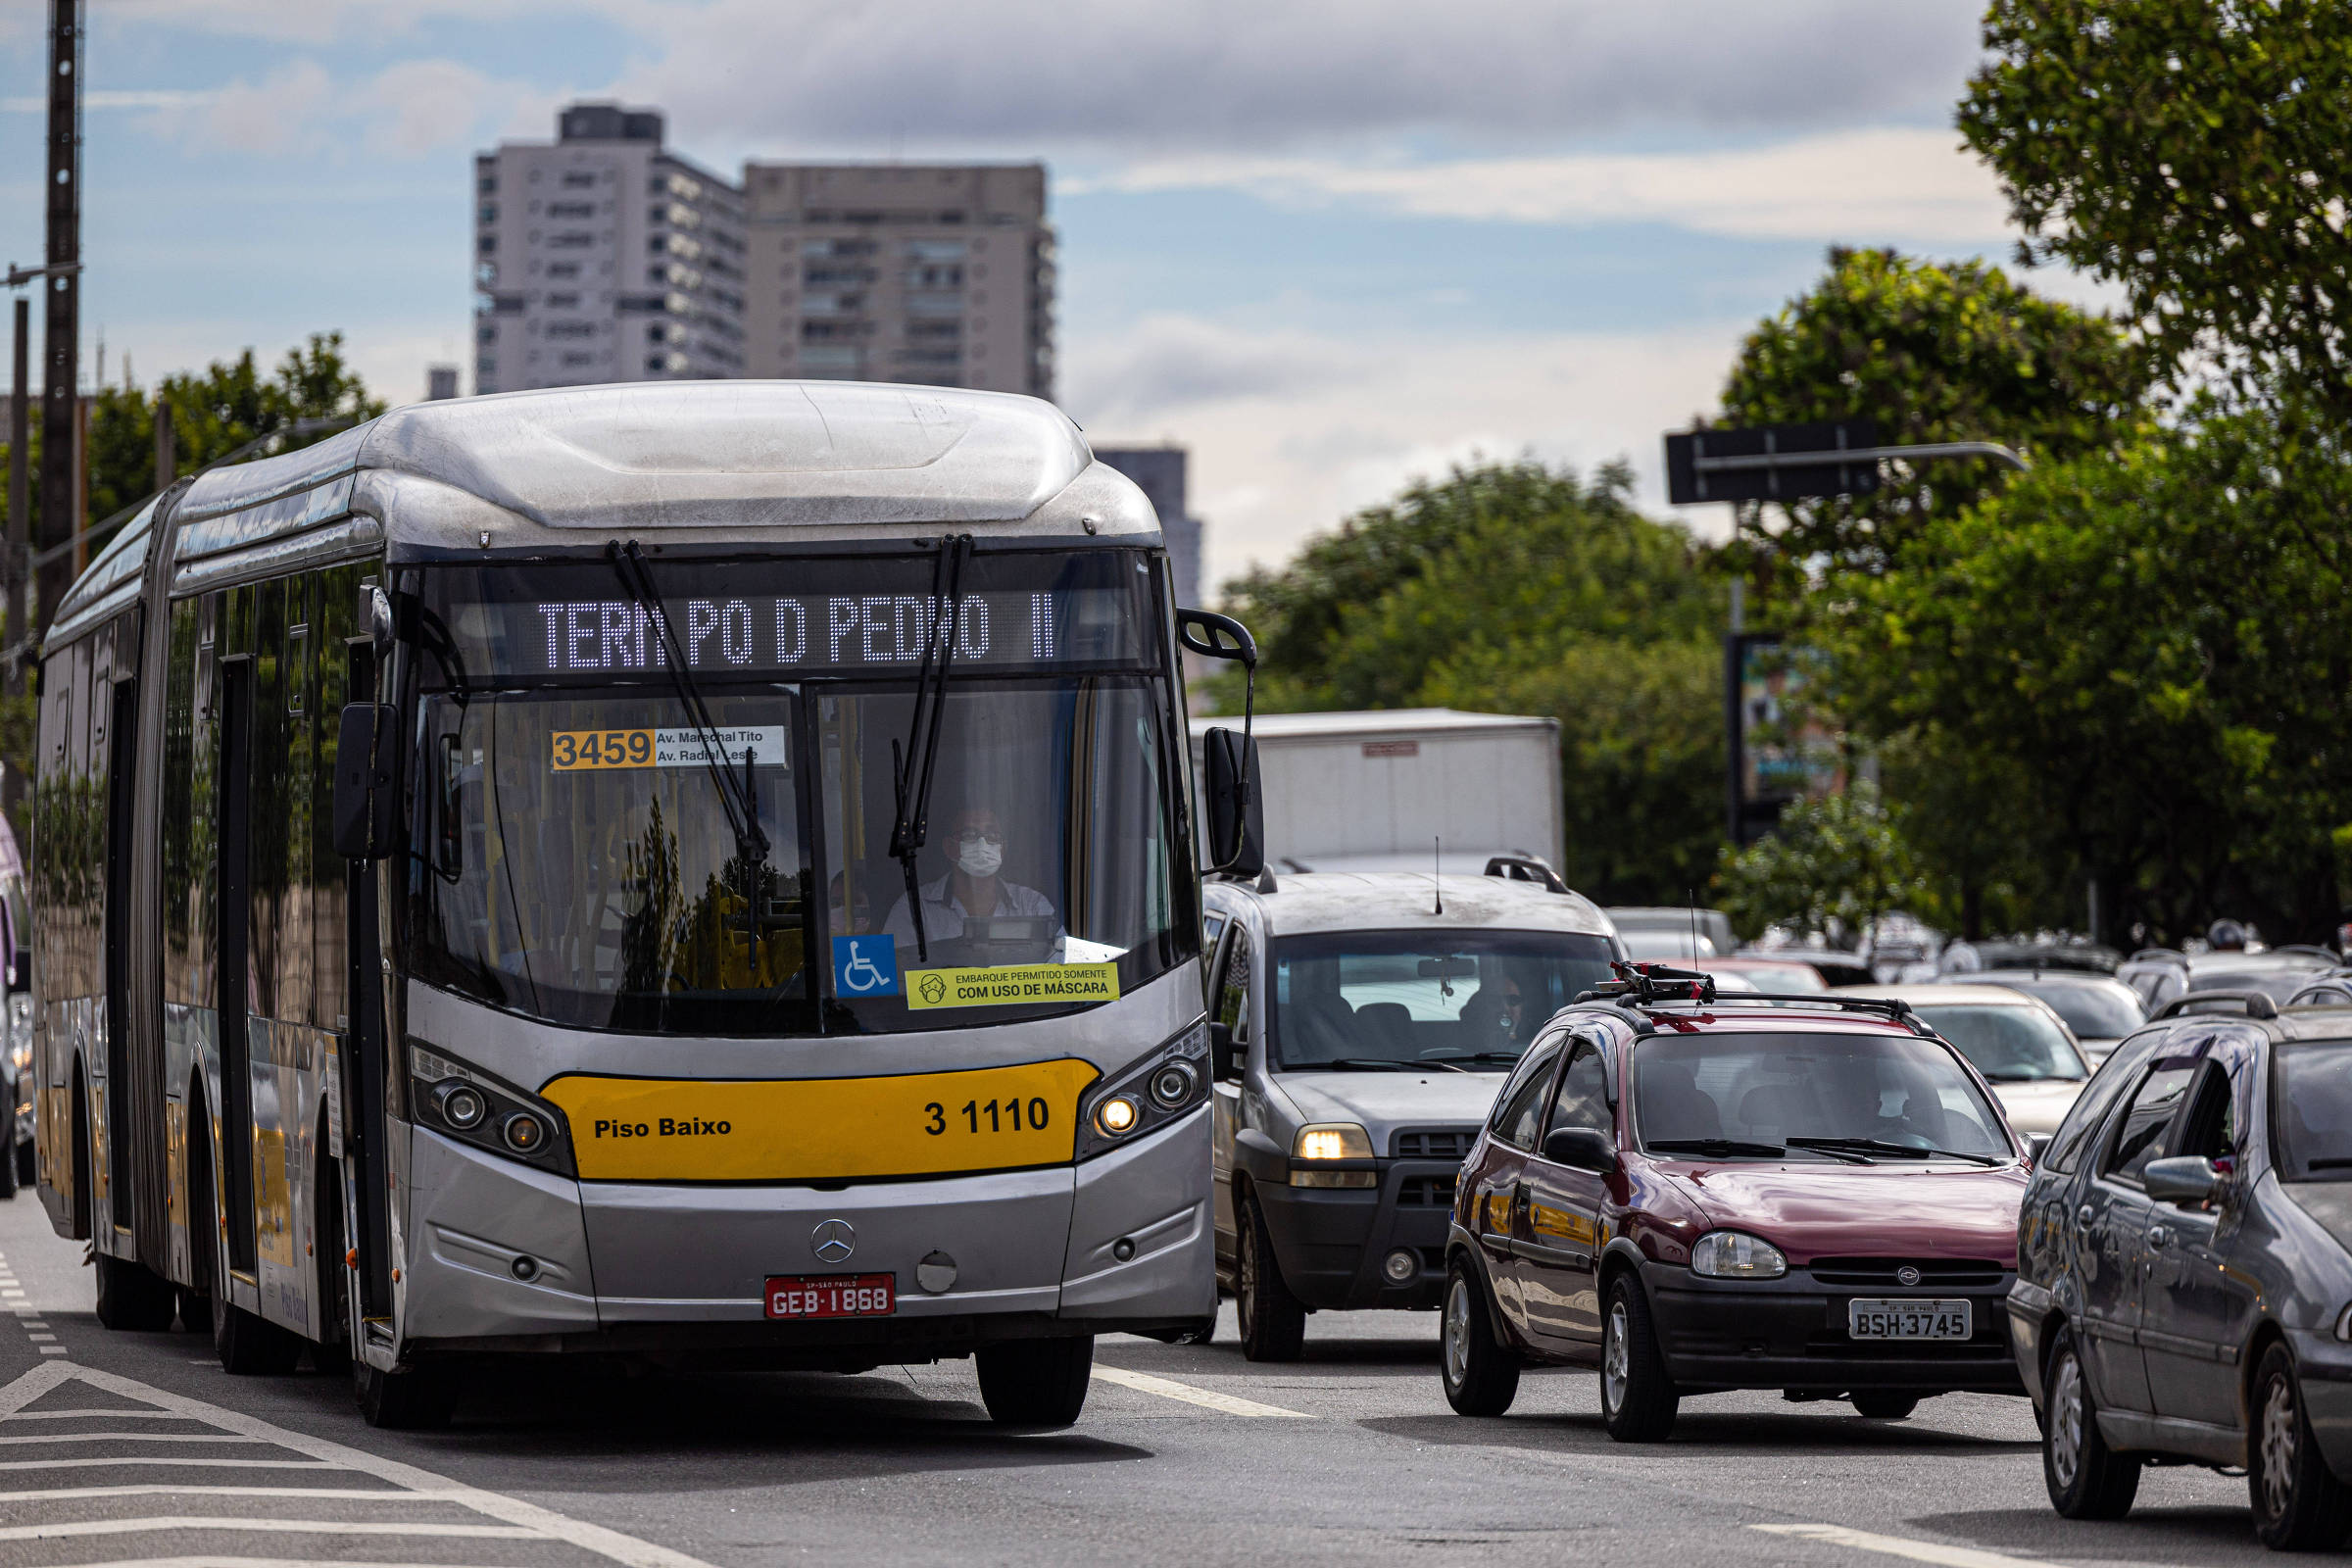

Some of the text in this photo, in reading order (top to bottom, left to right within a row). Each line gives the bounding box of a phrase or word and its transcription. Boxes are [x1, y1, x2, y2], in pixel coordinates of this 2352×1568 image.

[539, 602, 665, 667] TERM
[689, 600, 753, 665] PQ
[776, 598, 806, 663] D
[829, 595, 989, 662] PEDRO
[657, 733, 675, 744] Av.
[738, 730, 763, 742] Tito
[555, 732, 651, 766] 3459
[658, 751, 676, 761] Av.
[956, 969, 1106, 983] EMBARQUE PERMITIDO SOMENTE
[957, 980, 1108, 1000] COM USO DE MÁSCARA
[924, 1097, 1049, 1135] 3 1110
[595, 1116, 731, 1138] Piso Baixo
